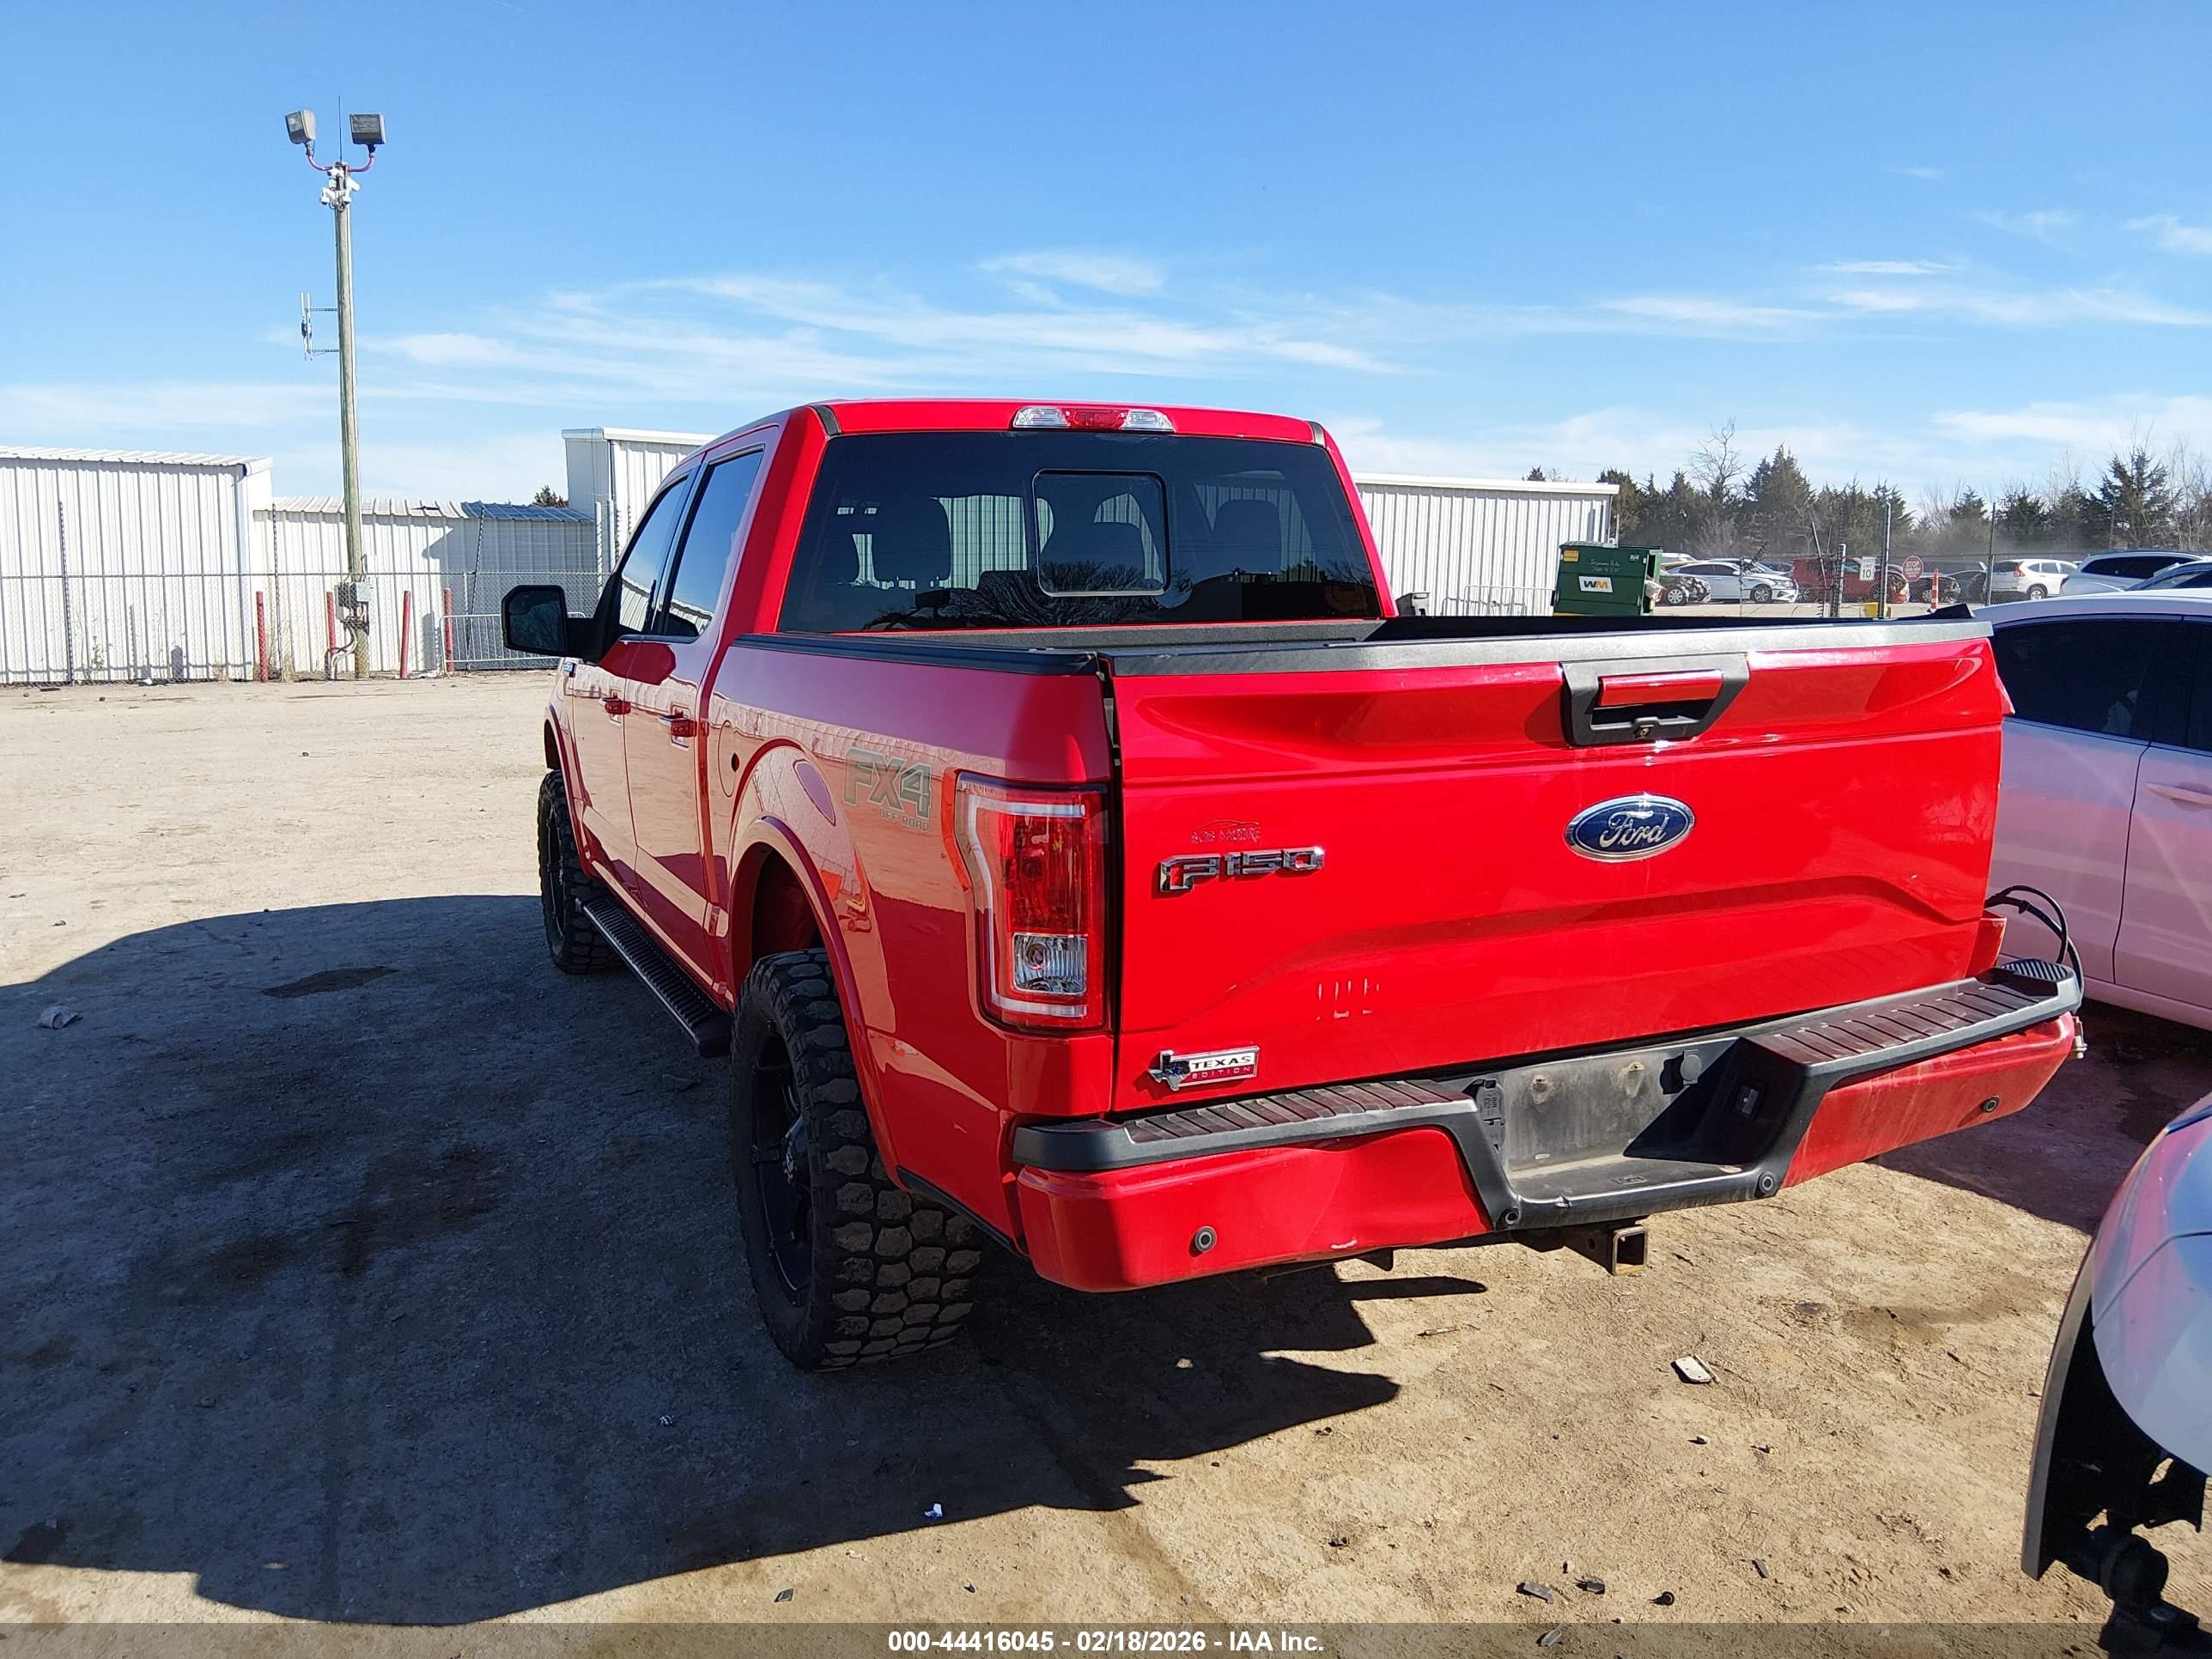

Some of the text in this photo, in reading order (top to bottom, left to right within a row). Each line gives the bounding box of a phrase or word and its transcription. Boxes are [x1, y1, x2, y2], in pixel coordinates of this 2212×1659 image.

[1862, 568, 1872, 579] 10
[843, 748, 932, 819] FX4
[879, 808, 929, 832] OFF ROAD
[1599, 810, 1670, 848] Ford
[1160, 846, 1325, 892] F150
[1191, 1066, 1252, 1079] EDITION
[1192, 1055, 1252, 1069] TEXAS
